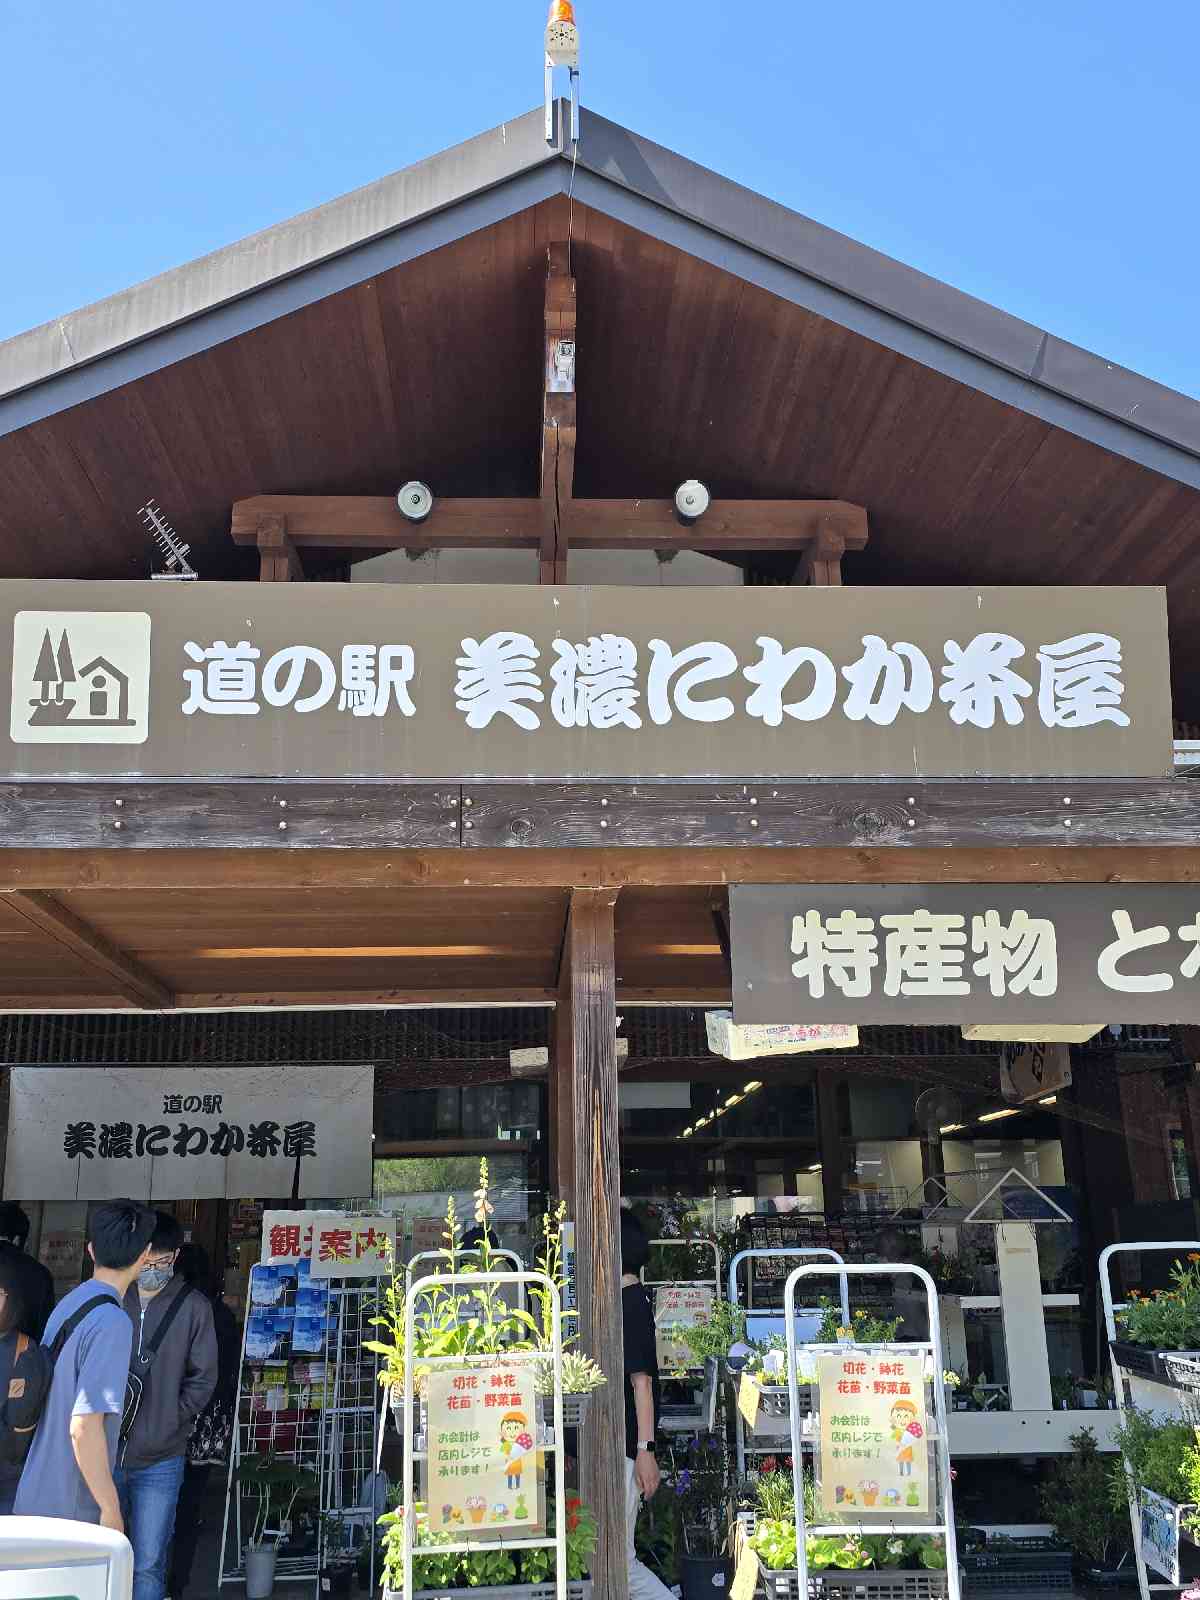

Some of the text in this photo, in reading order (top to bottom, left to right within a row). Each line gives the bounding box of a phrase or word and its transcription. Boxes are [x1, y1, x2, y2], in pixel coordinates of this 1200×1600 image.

[181, 631, 1131, 730] 道の駅 美濃にわか茶屋
[790, 909, 1200, 998] 特産物 と
[163, 1094, 223, 1115] 道の駅
[63, 1121, 317, 1160] 美濃にわか茶屋
